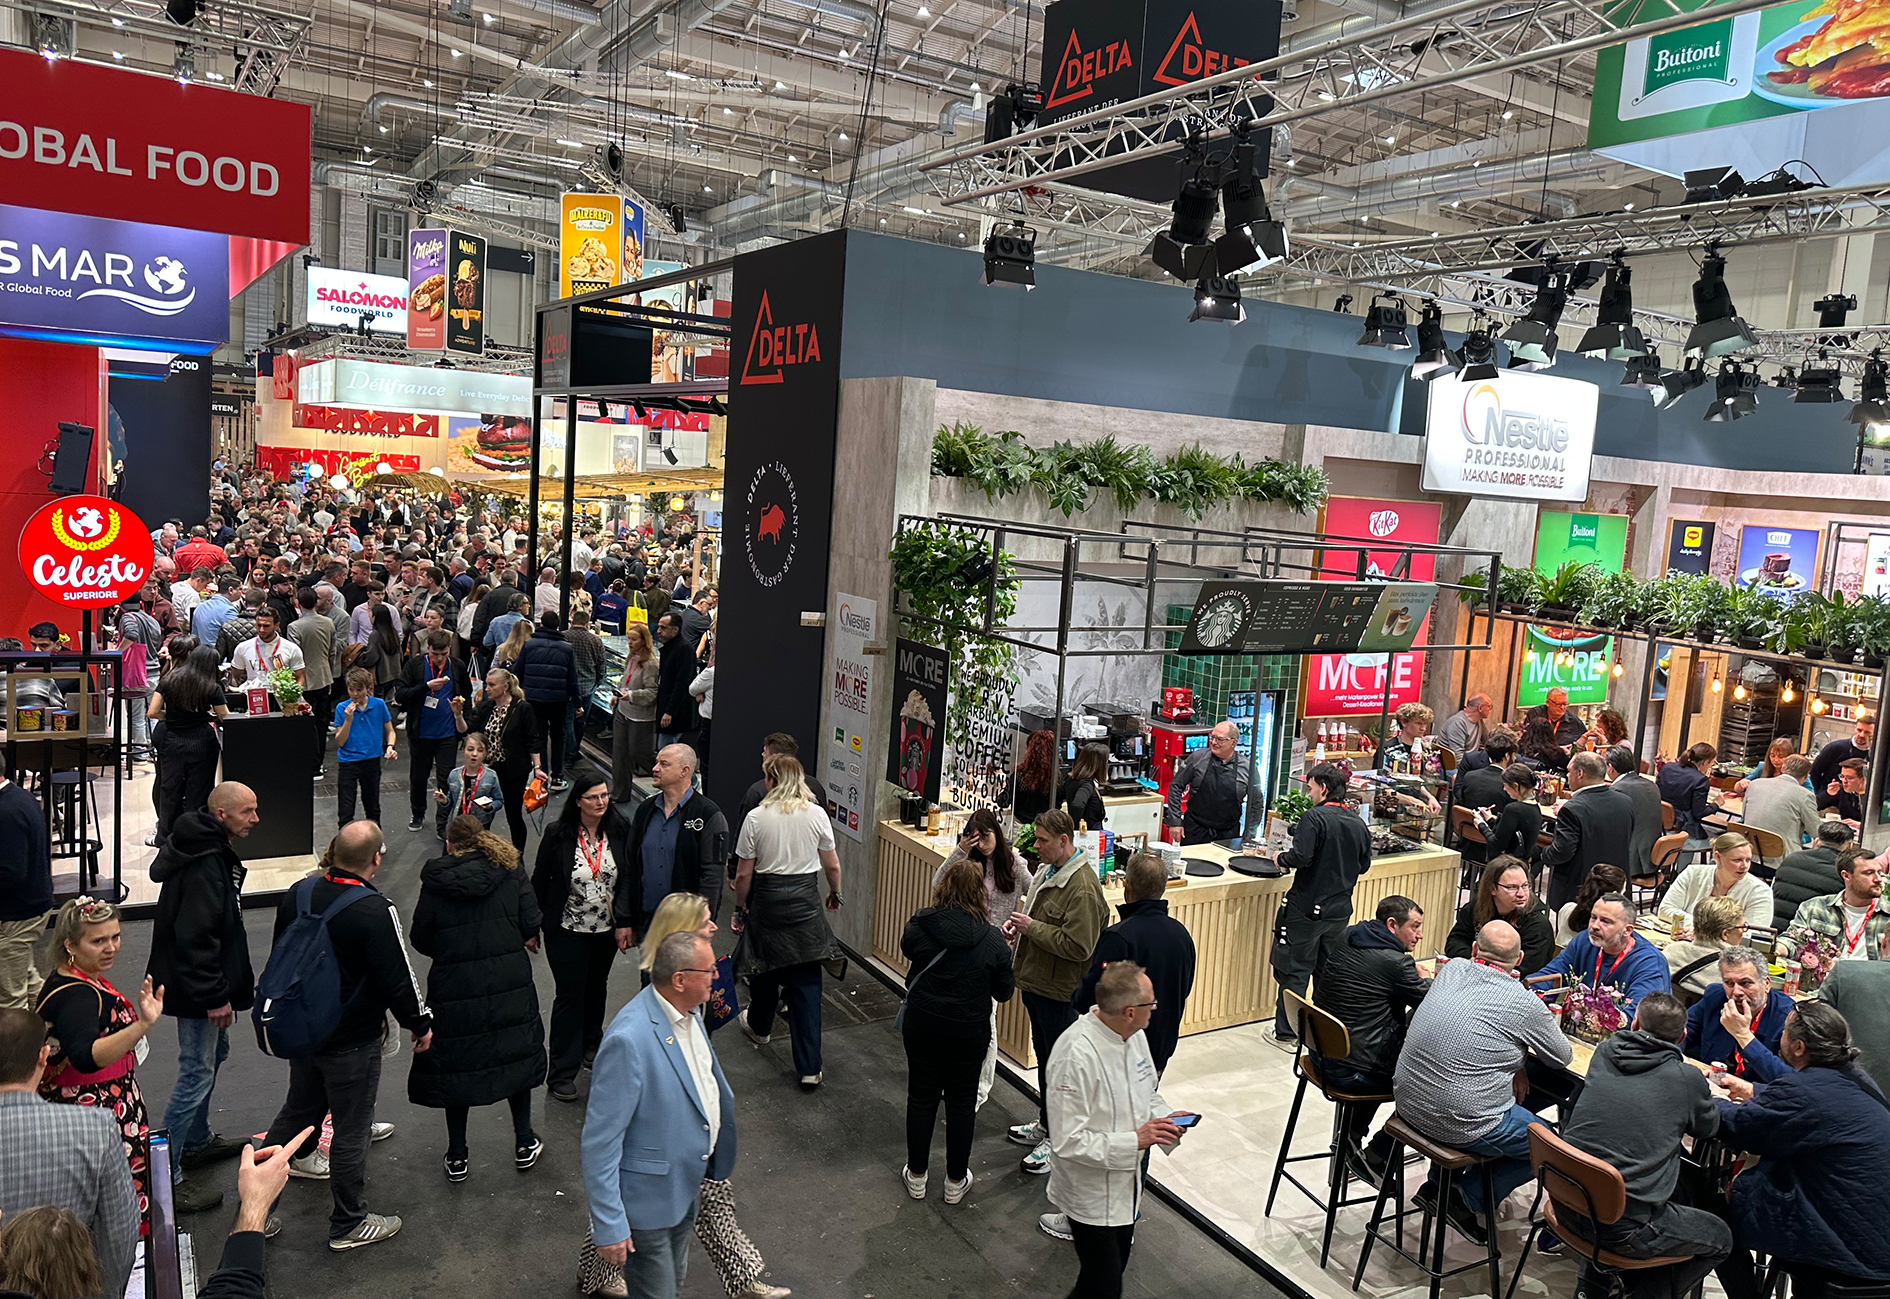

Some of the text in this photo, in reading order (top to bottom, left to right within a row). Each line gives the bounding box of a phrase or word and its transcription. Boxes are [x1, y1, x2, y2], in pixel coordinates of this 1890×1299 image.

[1066, 39, 1133, 89] DELTA
[1654, 41, 1721, 72] Buitoni
[1656, 61, 1718, 78] PROFESSIONAL
[1102, 98, 1120, 110] DER
[0, 120, 280, 198] OBAL FOOD
[412, 239, 444, 260] Milka
[31, 243, 136, 288] MAR
[6, 282, 43, 295] Global
[45, 286, 73, 298] Food
[316, 287, 407, 311] SALOMON
[330, 305, 394, 319] FOODWORLD
[759, 322, 821, 367] DELTA
[346, 370, 446, 397] Délifrance
[460, 389, 476, 398] Live
[477, 391, 510, 402] Everyday
[1484, 406, 1569, 453] Nestlé
[1465, 448, 1566, 472] PROFESSIONAL
[747, 465, 766, 504] DELTA
[1462, 467, 1565, 489] MAKING MORE POSSIBLE
[775, 461, 799, 538] LIEFERANT
[1571, 524, 1596, 538] Buitoni
[1769, 534, 1788, 543] CHEF
[33, 554, 144, 588] Celeste
[783, 543, 796, 573] DER
[63, 590, 118, 601] SUPERIORE
[1197, 589, 1252, 615] WE PROUDLY SERVE
[841, 626, 870, 639] PROFESSIONAL
[836, 657, 869, 680] MAKING
[900, 649, 944, 685] MORE
[836, 671, 868, 700] MORE
[974, 670, 1018, 695] PROUDLY
[834, 690, 867, 714] POSSIBLE
[960, 682, 1016, 715] SERVE
[957, 715, 1012, 750] PREMIUM
[955, 735, 1011, 774] COFFEE
